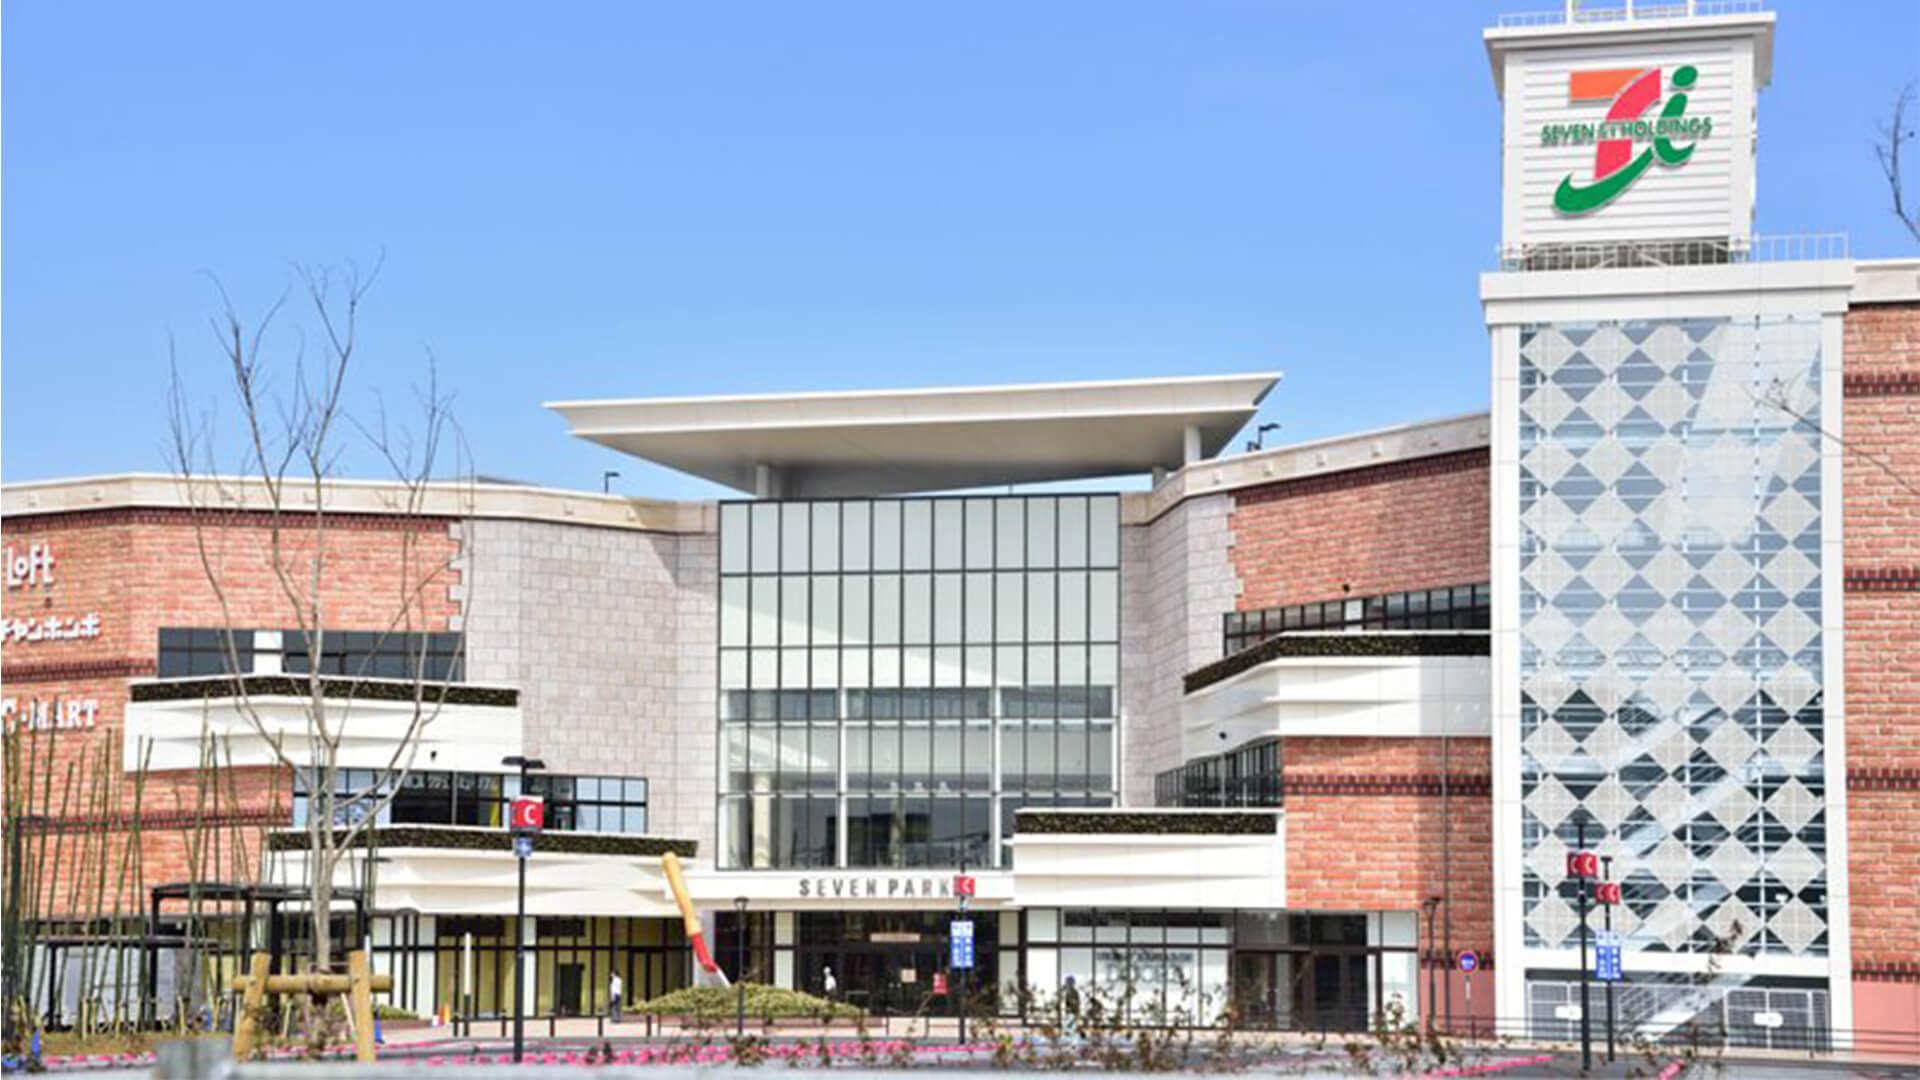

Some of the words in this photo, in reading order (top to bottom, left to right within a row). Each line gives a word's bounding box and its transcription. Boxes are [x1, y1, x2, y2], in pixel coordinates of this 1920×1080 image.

[1540, 123, 1595, 144] SEVEN
[1621, 116, 1713, 140] HOLDINGS
[524, 804, 536, 825] C
[799, 878, 877, 896] SEVEN
[888, 878, 949, 896] PARK
